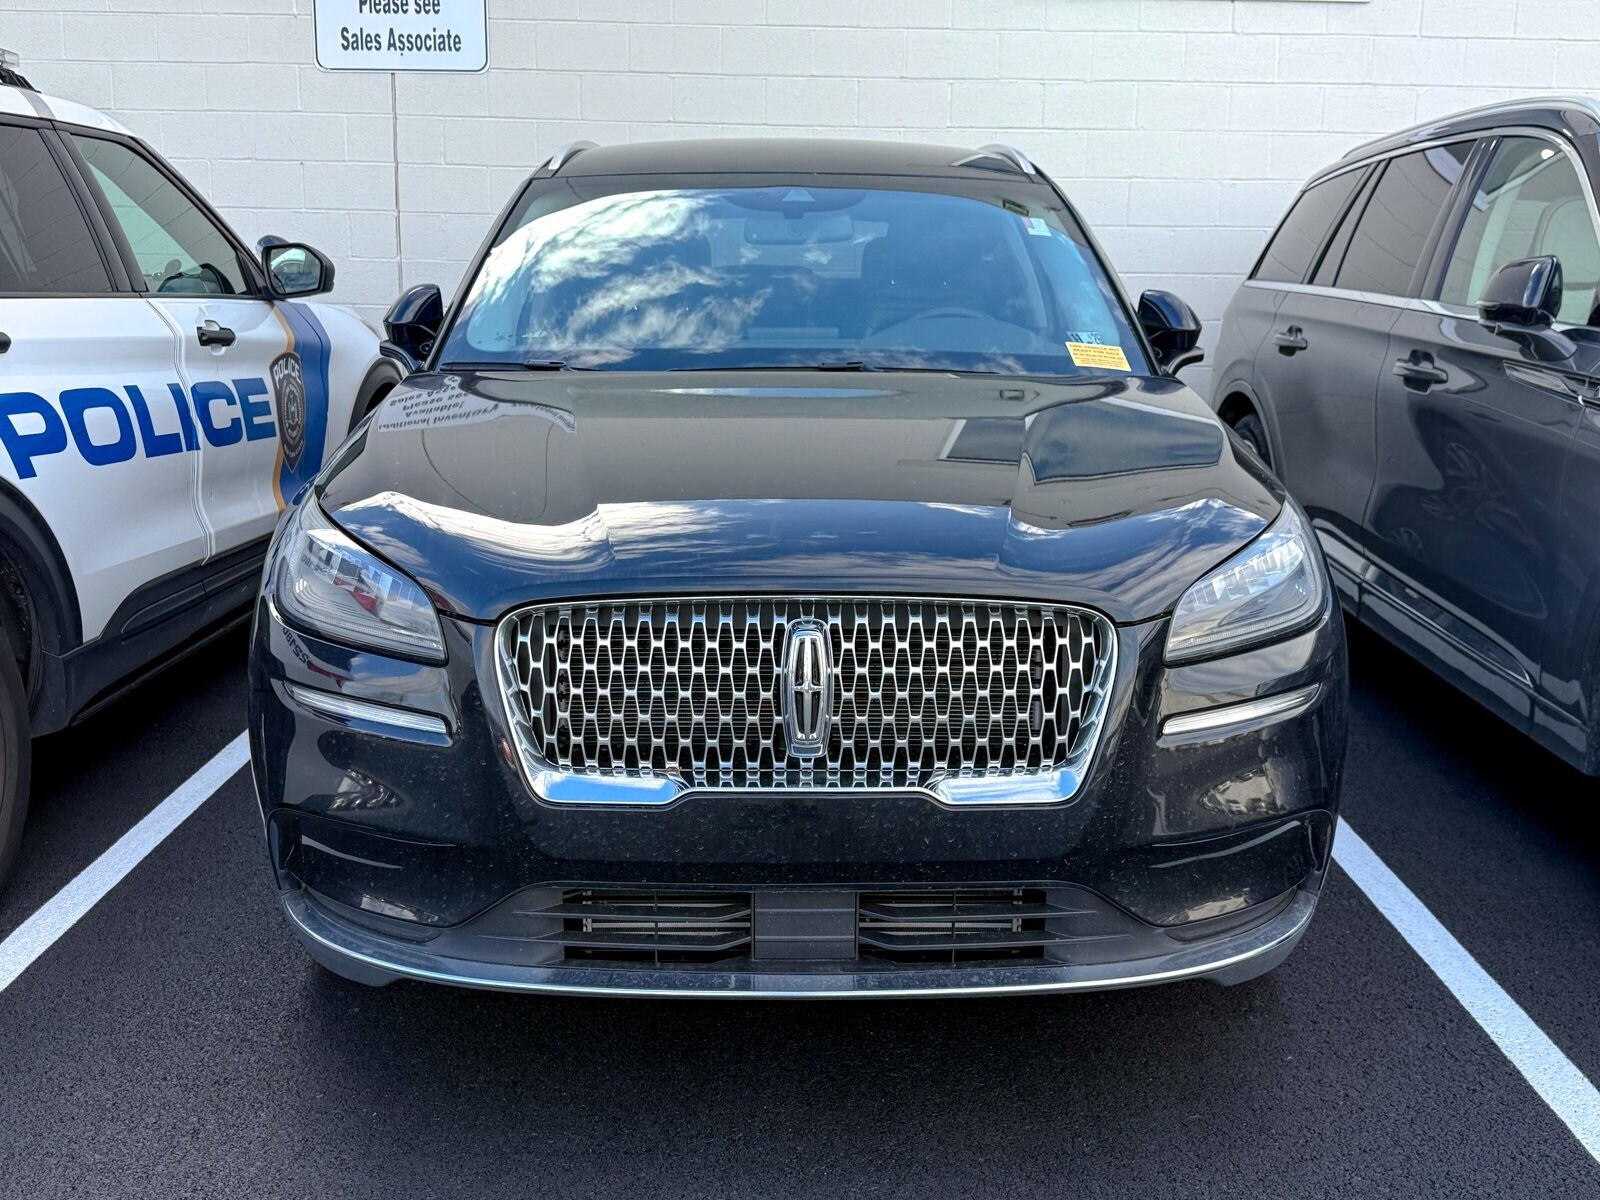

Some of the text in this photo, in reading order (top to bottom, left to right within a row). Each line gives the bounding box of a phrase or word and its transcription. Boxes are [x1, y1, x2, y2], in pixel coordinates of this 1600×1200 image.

[359, 0, 441, 14] Please see
[340, 26, 462, 52] Sales Associate
[273, 356, 302, 389] POLICE
[0, 377, 277, 480] POLICE
